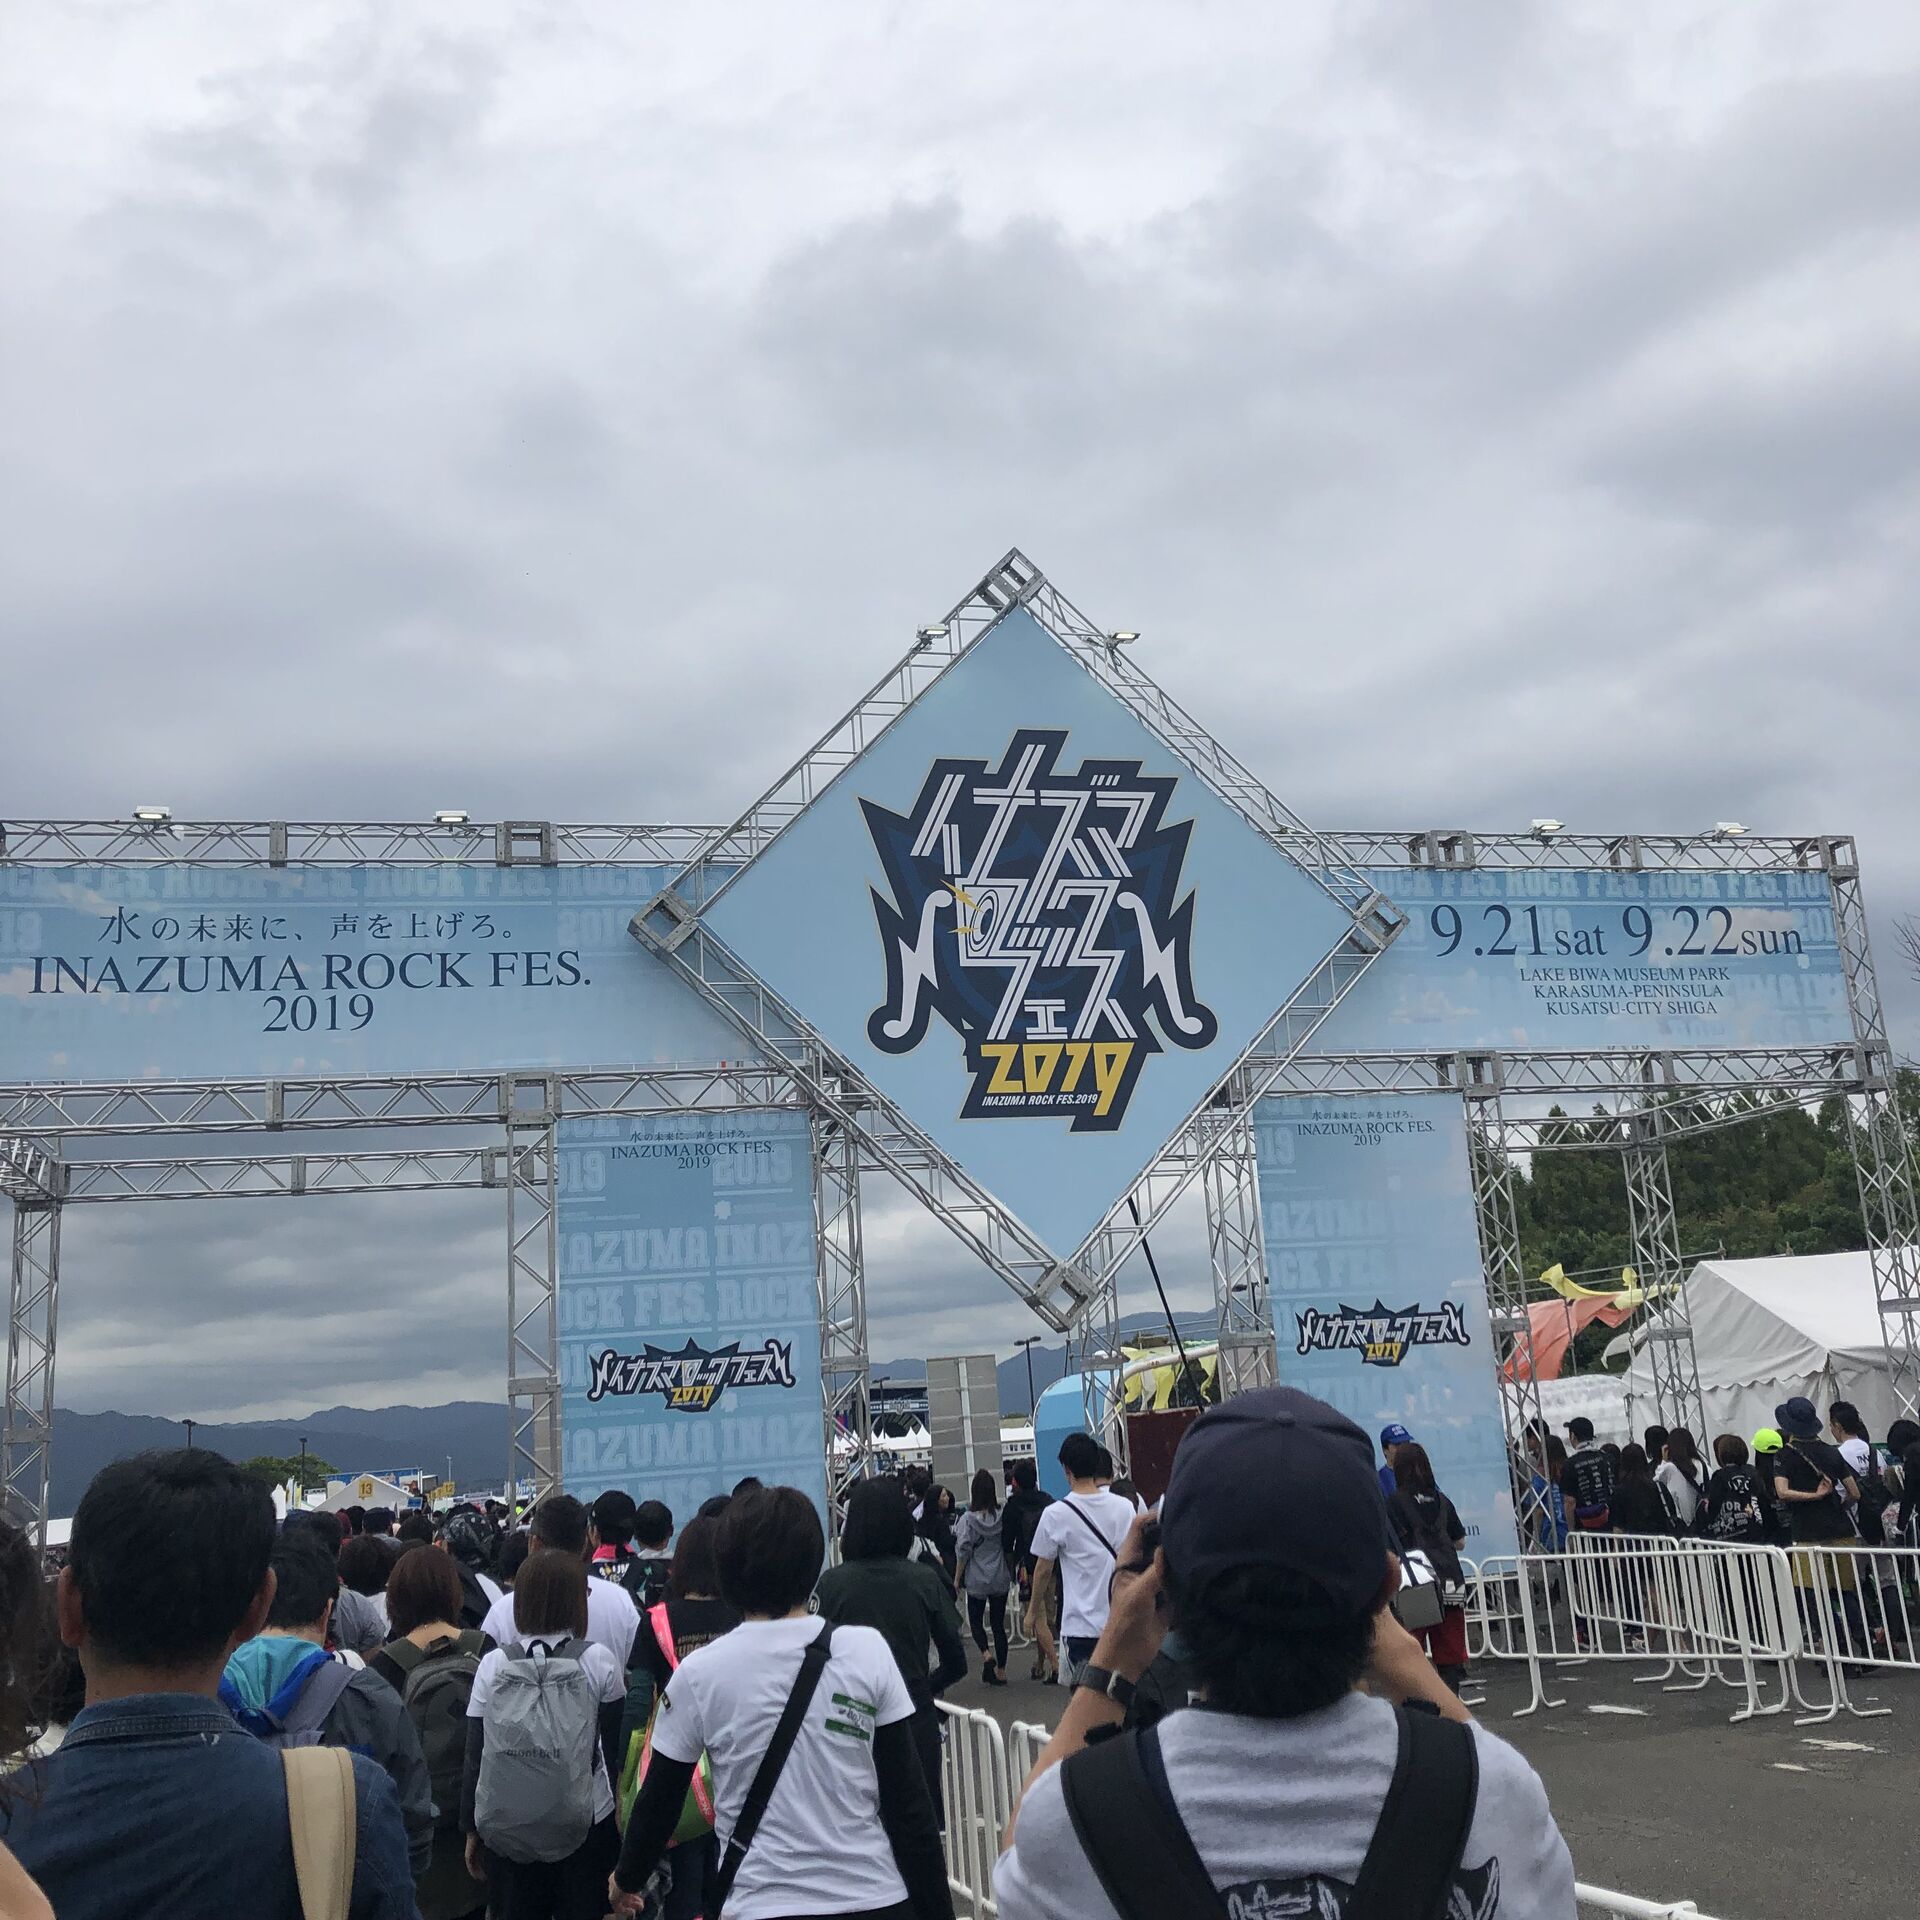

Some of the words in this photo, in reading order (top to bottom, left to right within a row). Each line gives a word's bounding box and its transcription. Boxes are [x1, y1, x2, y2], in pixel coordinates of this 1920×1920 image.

[98, 906, 512, 945] 水の未来に、声を上げろ。
[28, 954, 304, 994] INAZUMA
[322, 952, 474, 990] ROCK
[490, 949, 592, 989] FES.
[1520, 968, 1565, 982] LAKE
[1569, 968, 1611, 981] BIWA
[1614, 967, 1685, 981] MUSEUM
[1689, 967, 1730, 980] PARK
[1534, 983, 1724, 998] KARASUMA-PENINSULA
[262, 994, 375, 1032] 2019
[1546, 1001, 1662, 1015] KUSATSU-CITY
[1667, 1001, 1718, 1014] SHIGA
[980, 1042, 1135, 1116] 2019
[981, 1096, 1026, 1106] INAZUMA
[1028, 1095, 1054, 1106] ROCK
[1298, 1122, 1364, 1136] INAZUMA
[1367, 1121, 1404, 1134] ROCK
[1408, 1120, 1436, 1133] FES.
[1354, 1134, 1381, 1146] 2019
[611, 1144, 693, 1160] INAZUMA
[695, 1142, 738, 1156] ROCK
[743, 1140, 775, 1154] FES.
[678, 1156, 711, 1169] 2019
[1365, 1343, 1402, 1363] 2019
[670, 1386, 714, 1407] 2019
[360, 1482, 372, 1495] 13
